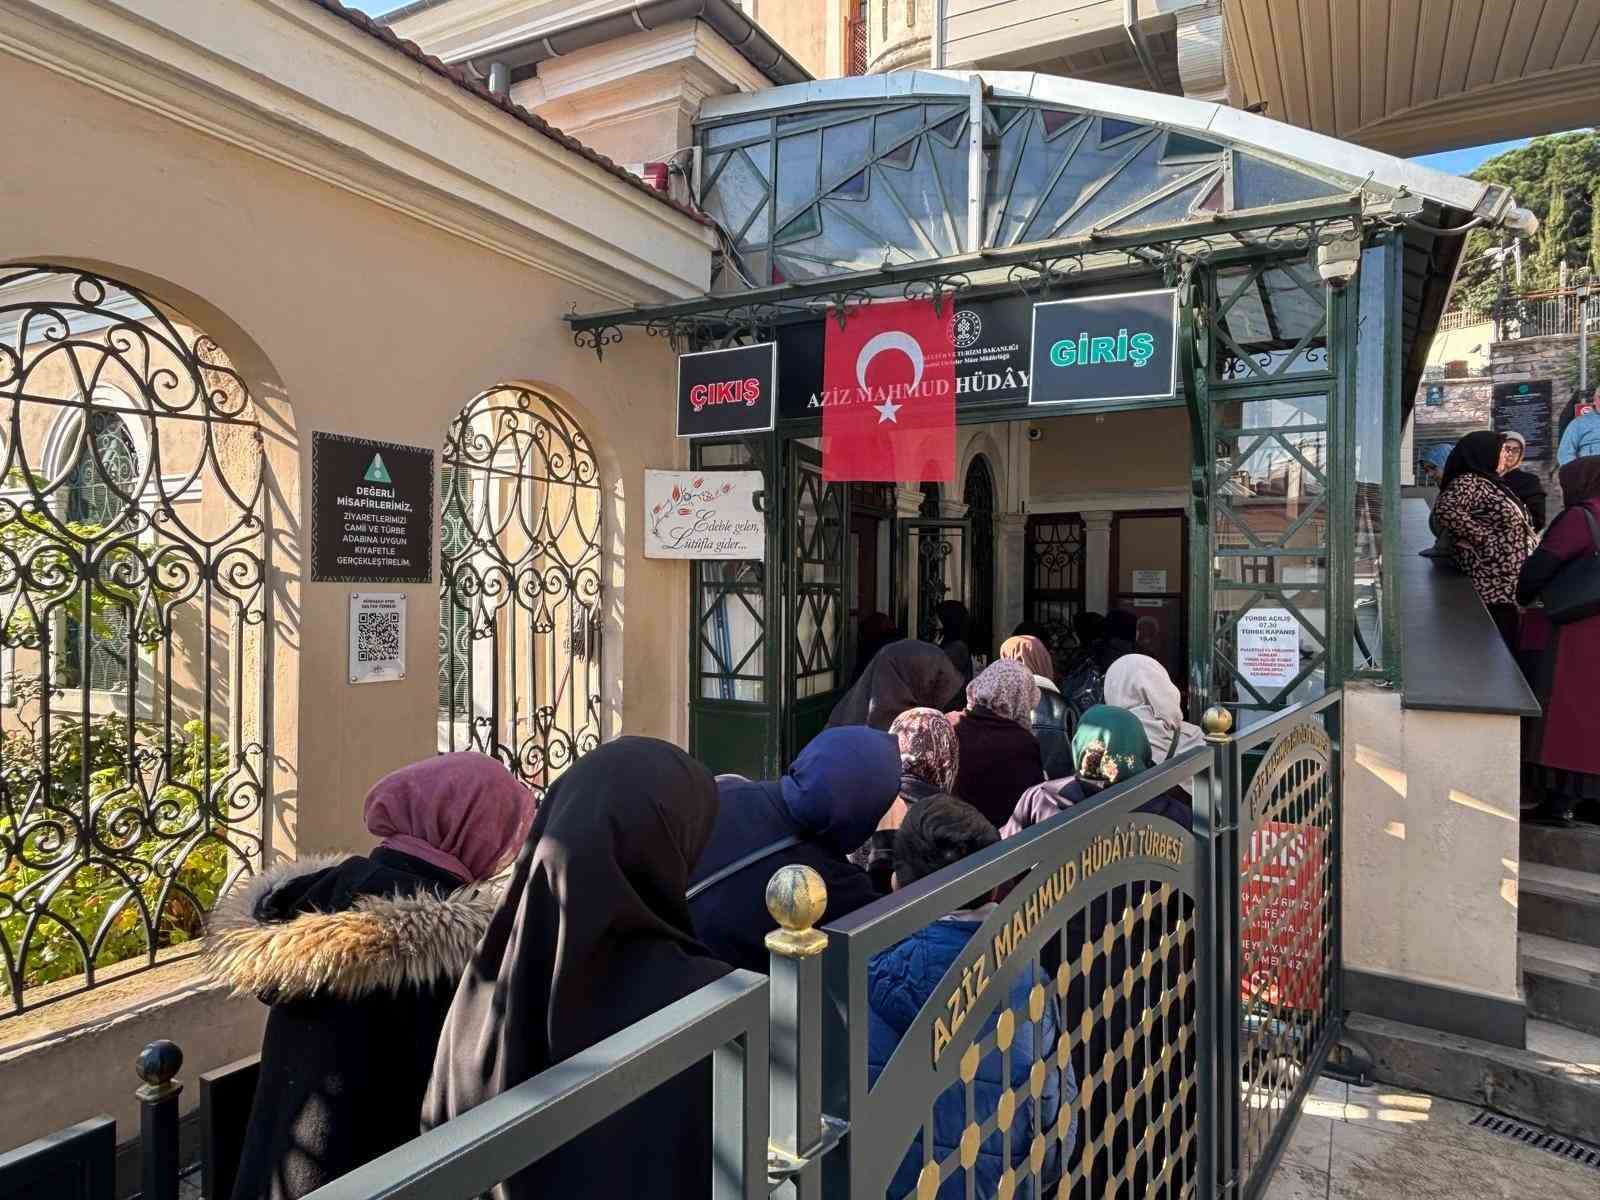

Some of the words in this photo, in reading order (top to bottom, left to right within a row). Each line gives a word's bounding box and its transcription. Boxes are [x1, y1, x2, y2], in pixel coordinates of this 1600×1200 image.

[982, 344, 1019, 354] BAKANLIĞI
[1050, 328, 1154, 367] GİRİŞ
[807, 387, 852, 408] AZİZ
[855, 379, 950, 404] MAHMUD
[955, 366, 1030, 393] HÜDÂY
[690, 378, 760, 412] ÇIKIŞ
[356, 486, 395, 498] DEĞERLİ
[369, 525, 380, 533] VE
[381, 525, 406, 535] TÜRBE
[732, 519, 760, 536] gelen,
[342, 534, 378, 544] ADABINA
[380, 537, 407, 545] UYGUN
[354, 547, 396, 555] KIYAFETLE
[931, 954, 991, 1065] AZİZ
[992, 859, 1077, 970] MAHMUD
[1080, 822, 1137, 881] HÜDÂYÎ
[1138, 824, 1184, 865] TÜRBESİ
